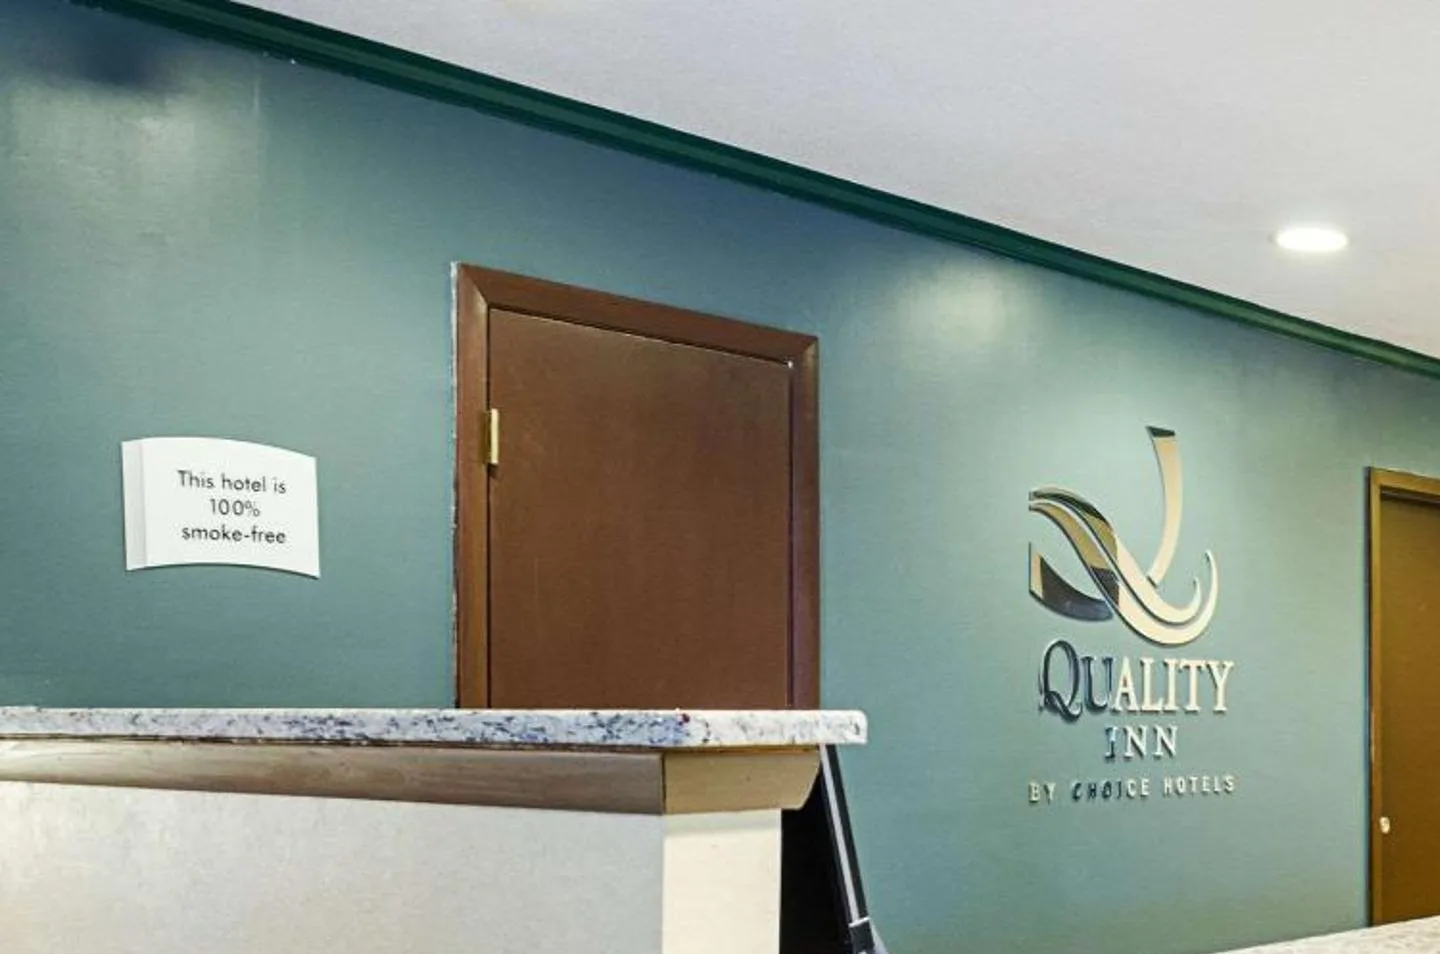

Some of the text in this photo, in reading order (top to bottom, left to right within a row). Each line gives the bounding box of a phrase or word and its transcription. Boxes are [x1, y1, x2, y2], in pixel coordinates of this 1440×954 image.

[177, 469, 287, 494] This hotel is
[209, 498, 261, 517] 100%
[181, 525, 287, 544] smoke-free
[1039, 639, 1234, 722] QUALITY
[1104, 725, 1178, 763] INN
[1028, 775, 1236, 804] BY CHOICE HOTELS
